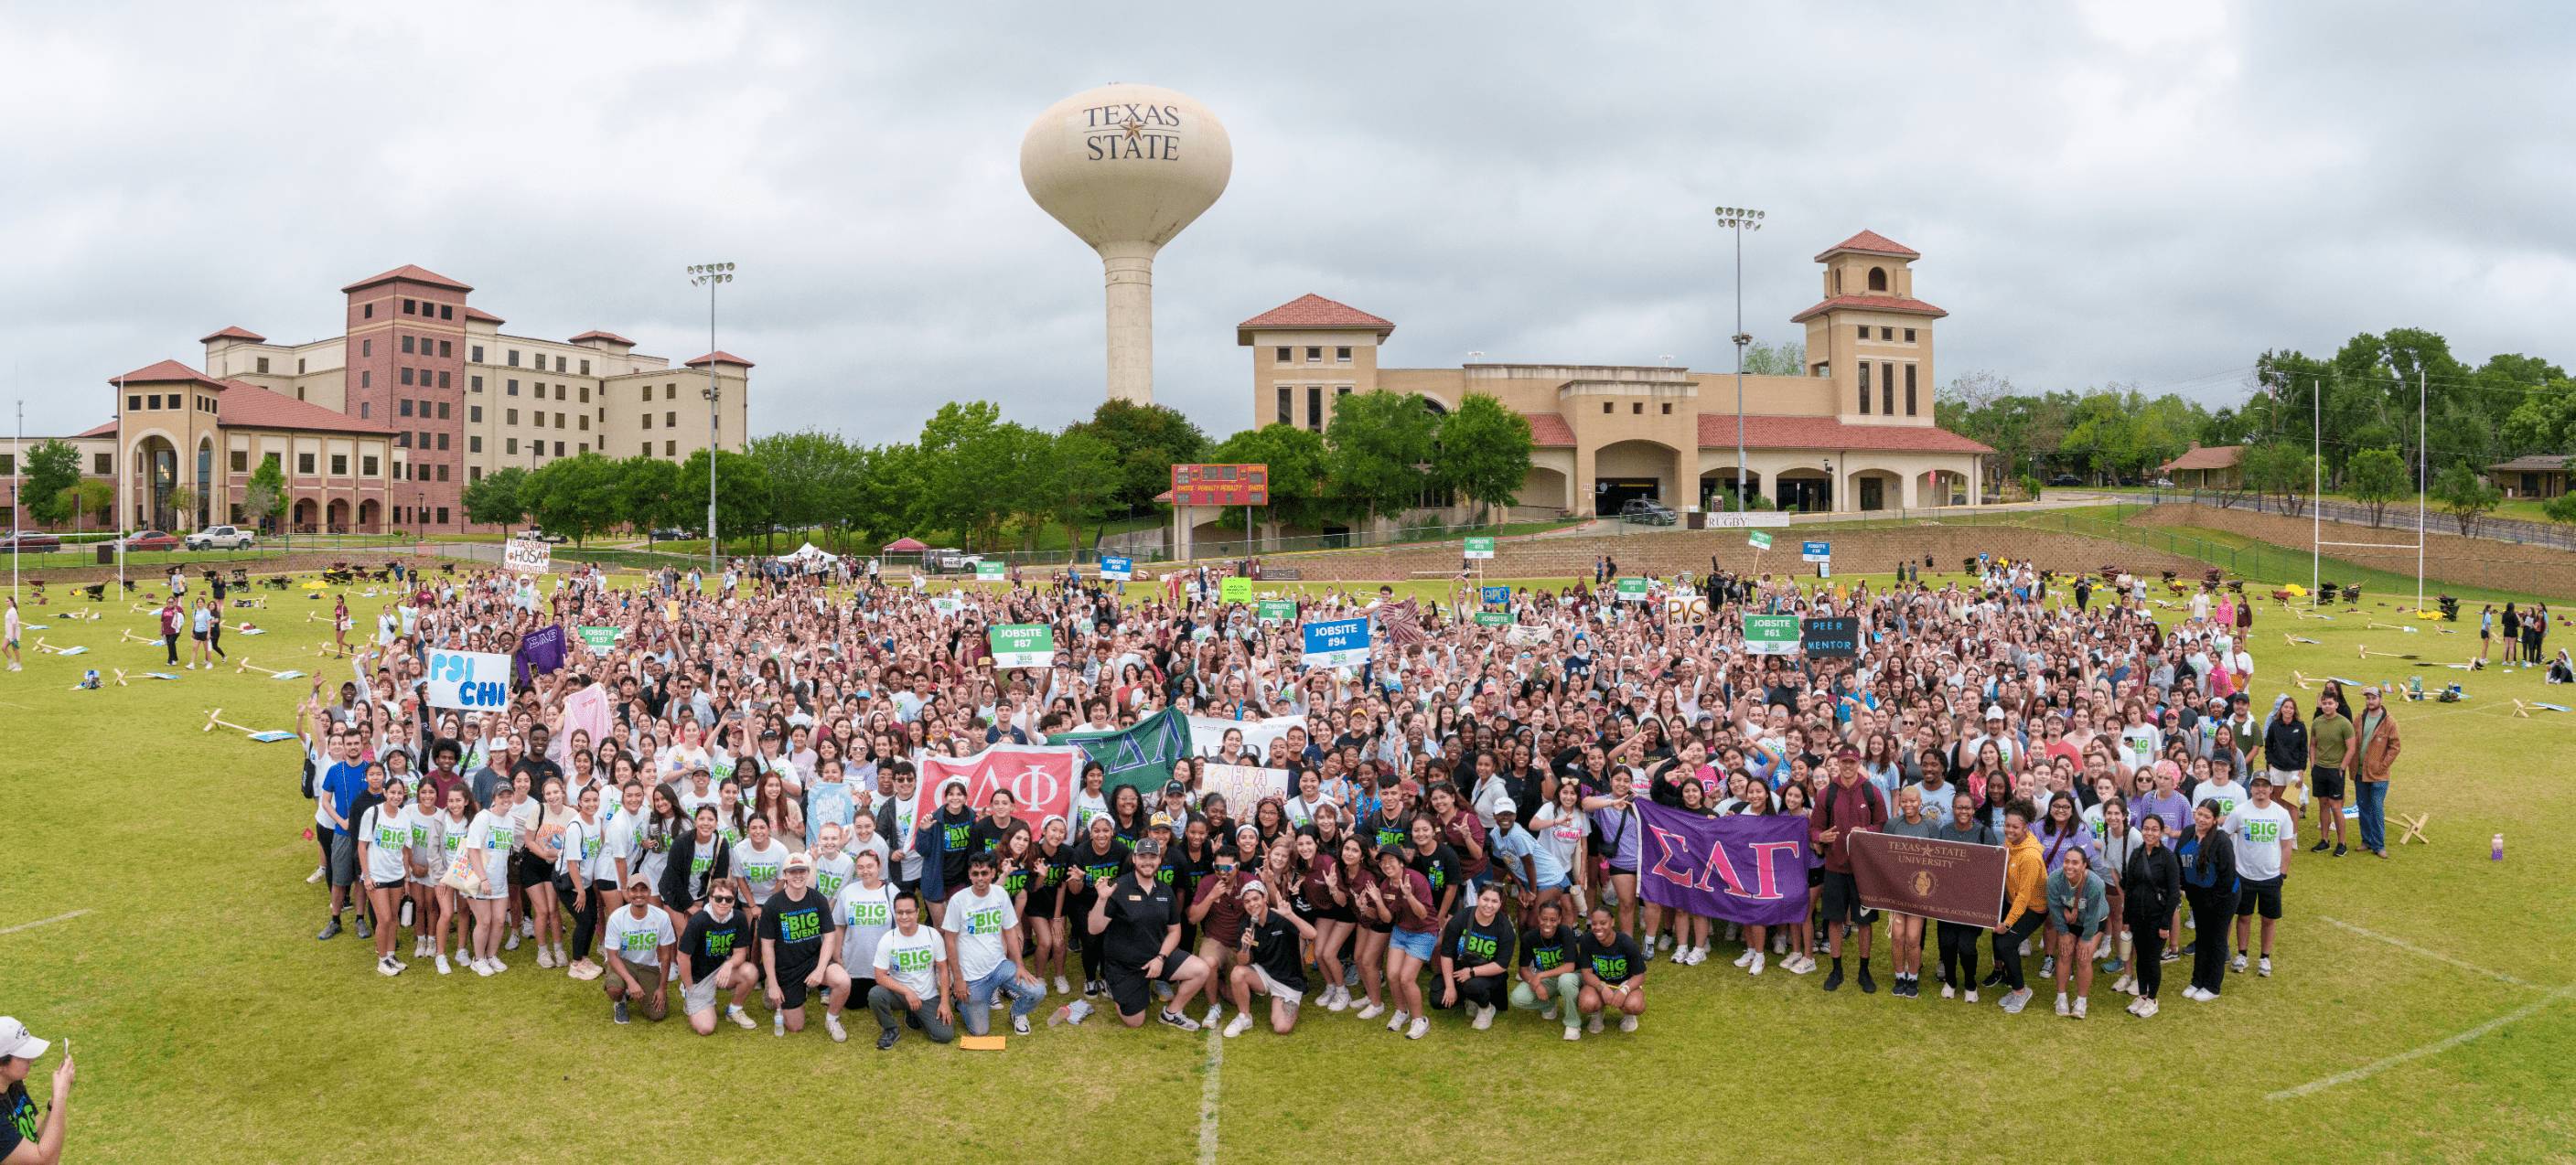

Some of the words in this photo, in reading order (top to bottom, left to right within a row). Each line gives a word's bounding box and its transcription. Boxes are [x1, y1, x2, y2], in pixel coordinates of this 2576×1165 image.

[1083, 103, 1180, 127] TEXAS
[1087, 134, 1180, 161] STATE
[1709, 518, 1747, 527] RUGBY
[514, 550, 543, 563] HOSA
[1668, 598, 1706, 625] PVS
[1754, 619, 1791, 627] JOBSITE
[1813, 621, 1842, 630] PEER
[1001, 628, 1042, 638] JOBSITE
[1315, 624, 1358, 636] JOBSITE
[1764, 629, 1780, 637] #61
[1014, 639, 1031, 647] #87
[1328, 636, 1347, 647] #94
[1808, 640, 1852, 650] MENTOR
[431, 653, 475, 682] PSI
[459, 681, 505, 707] CHI
[2251, 823, 2277, 834] BIG
[381, 830, 405, 841] BIG
[495, 829, 512, 842] BIG
[1382, 832, 1405, 845] BIG
[1888, 841, 1920, 852] TEXAS
[1934, 846, 1967, 857] STATE
[1648, 824, 1799, 899] ΣΛΓ
[1898, 856, 1954, 868] UNIVERSITY
[751, 865, 777, 879] BIG
[855, 905, 886, 917] BIG
[1928, 904, 1949, 914] BLACK
[788, 913, 819, 932] BIG
[855, 917, 886, 925] EVENT
[975, 910, 1002, 926] BIG
[628, 932, 657, 946] BIG
[790, 926, 821, 940] EVENT
[711, 932, 735, 948] BIG
[1467, 936, 1497, 955] BIG
[628, 944, 657, 952] EVENT
[899, 950, 932, 966] BIG
[1600, 959, 1627, 972] BIG
